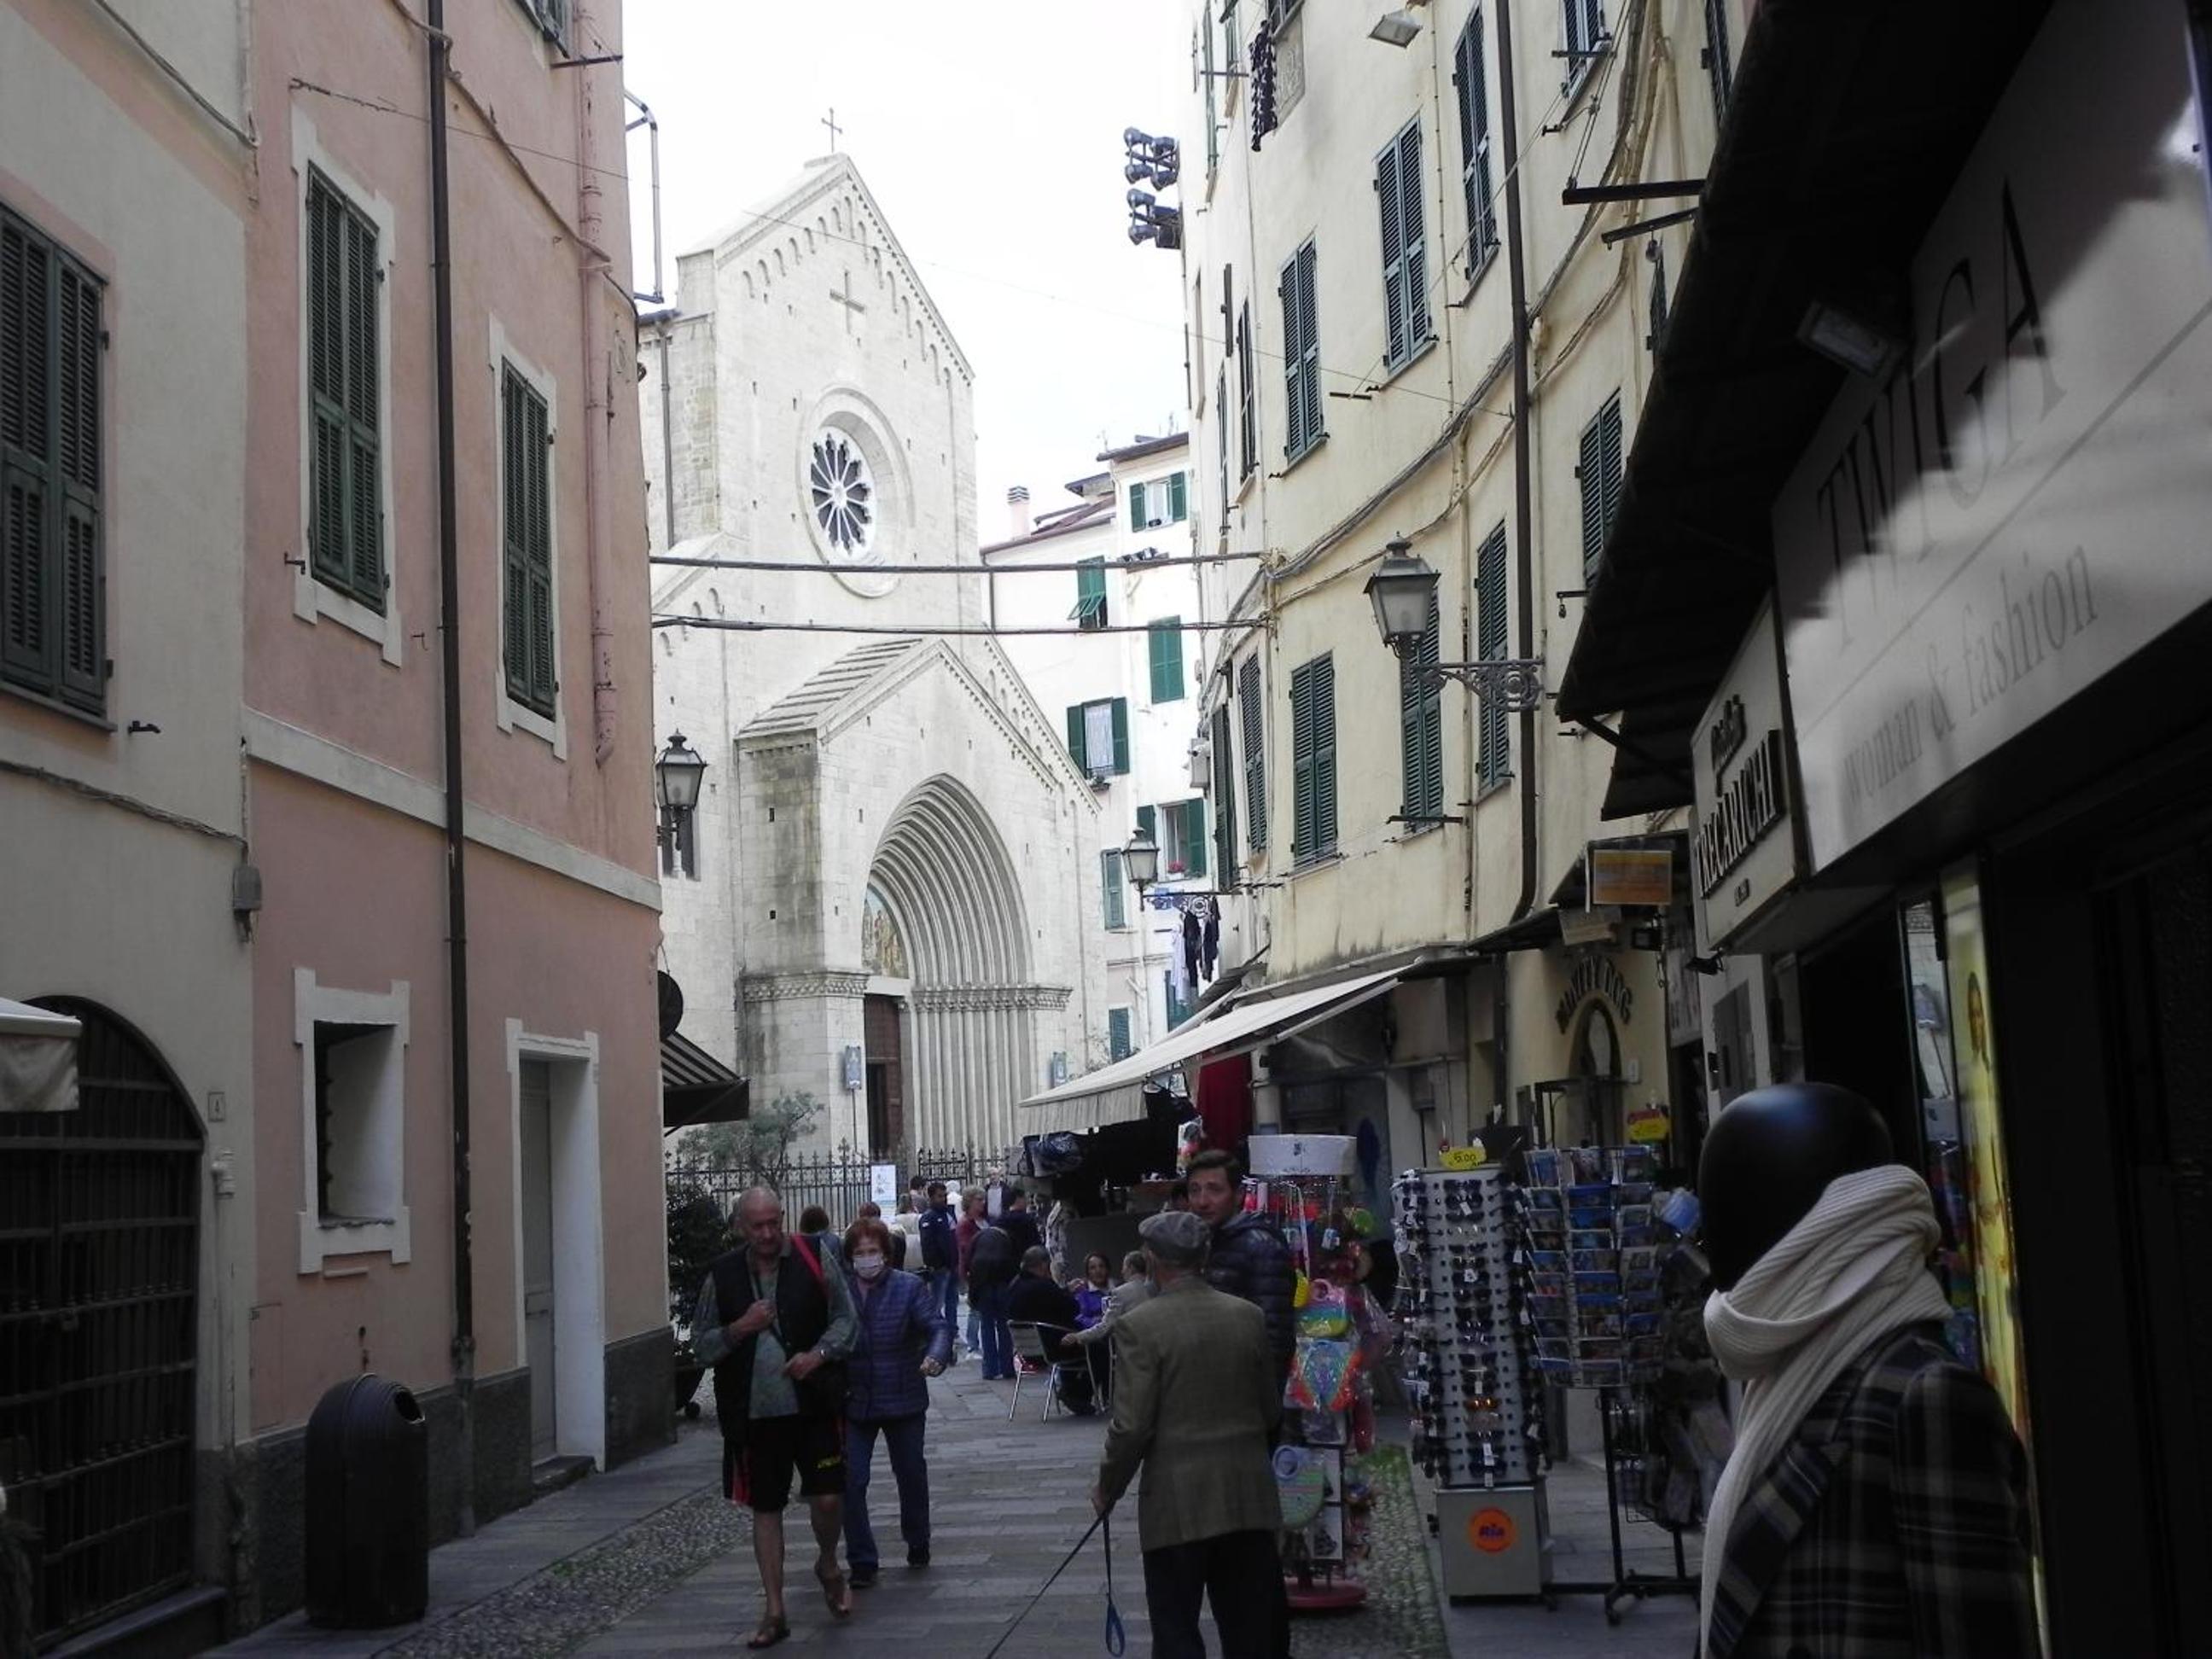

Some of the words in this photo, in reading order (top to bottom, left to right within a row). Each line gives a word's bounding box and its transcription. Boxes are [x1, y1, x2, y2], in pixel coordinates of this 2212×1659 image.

[1843, 697, 1923, 805] woman
[1926, 640, 1957, 743] &
[1963, 544, 2099, 717] fashion
[1694, 730, 1782, 898] TRECARICHI
